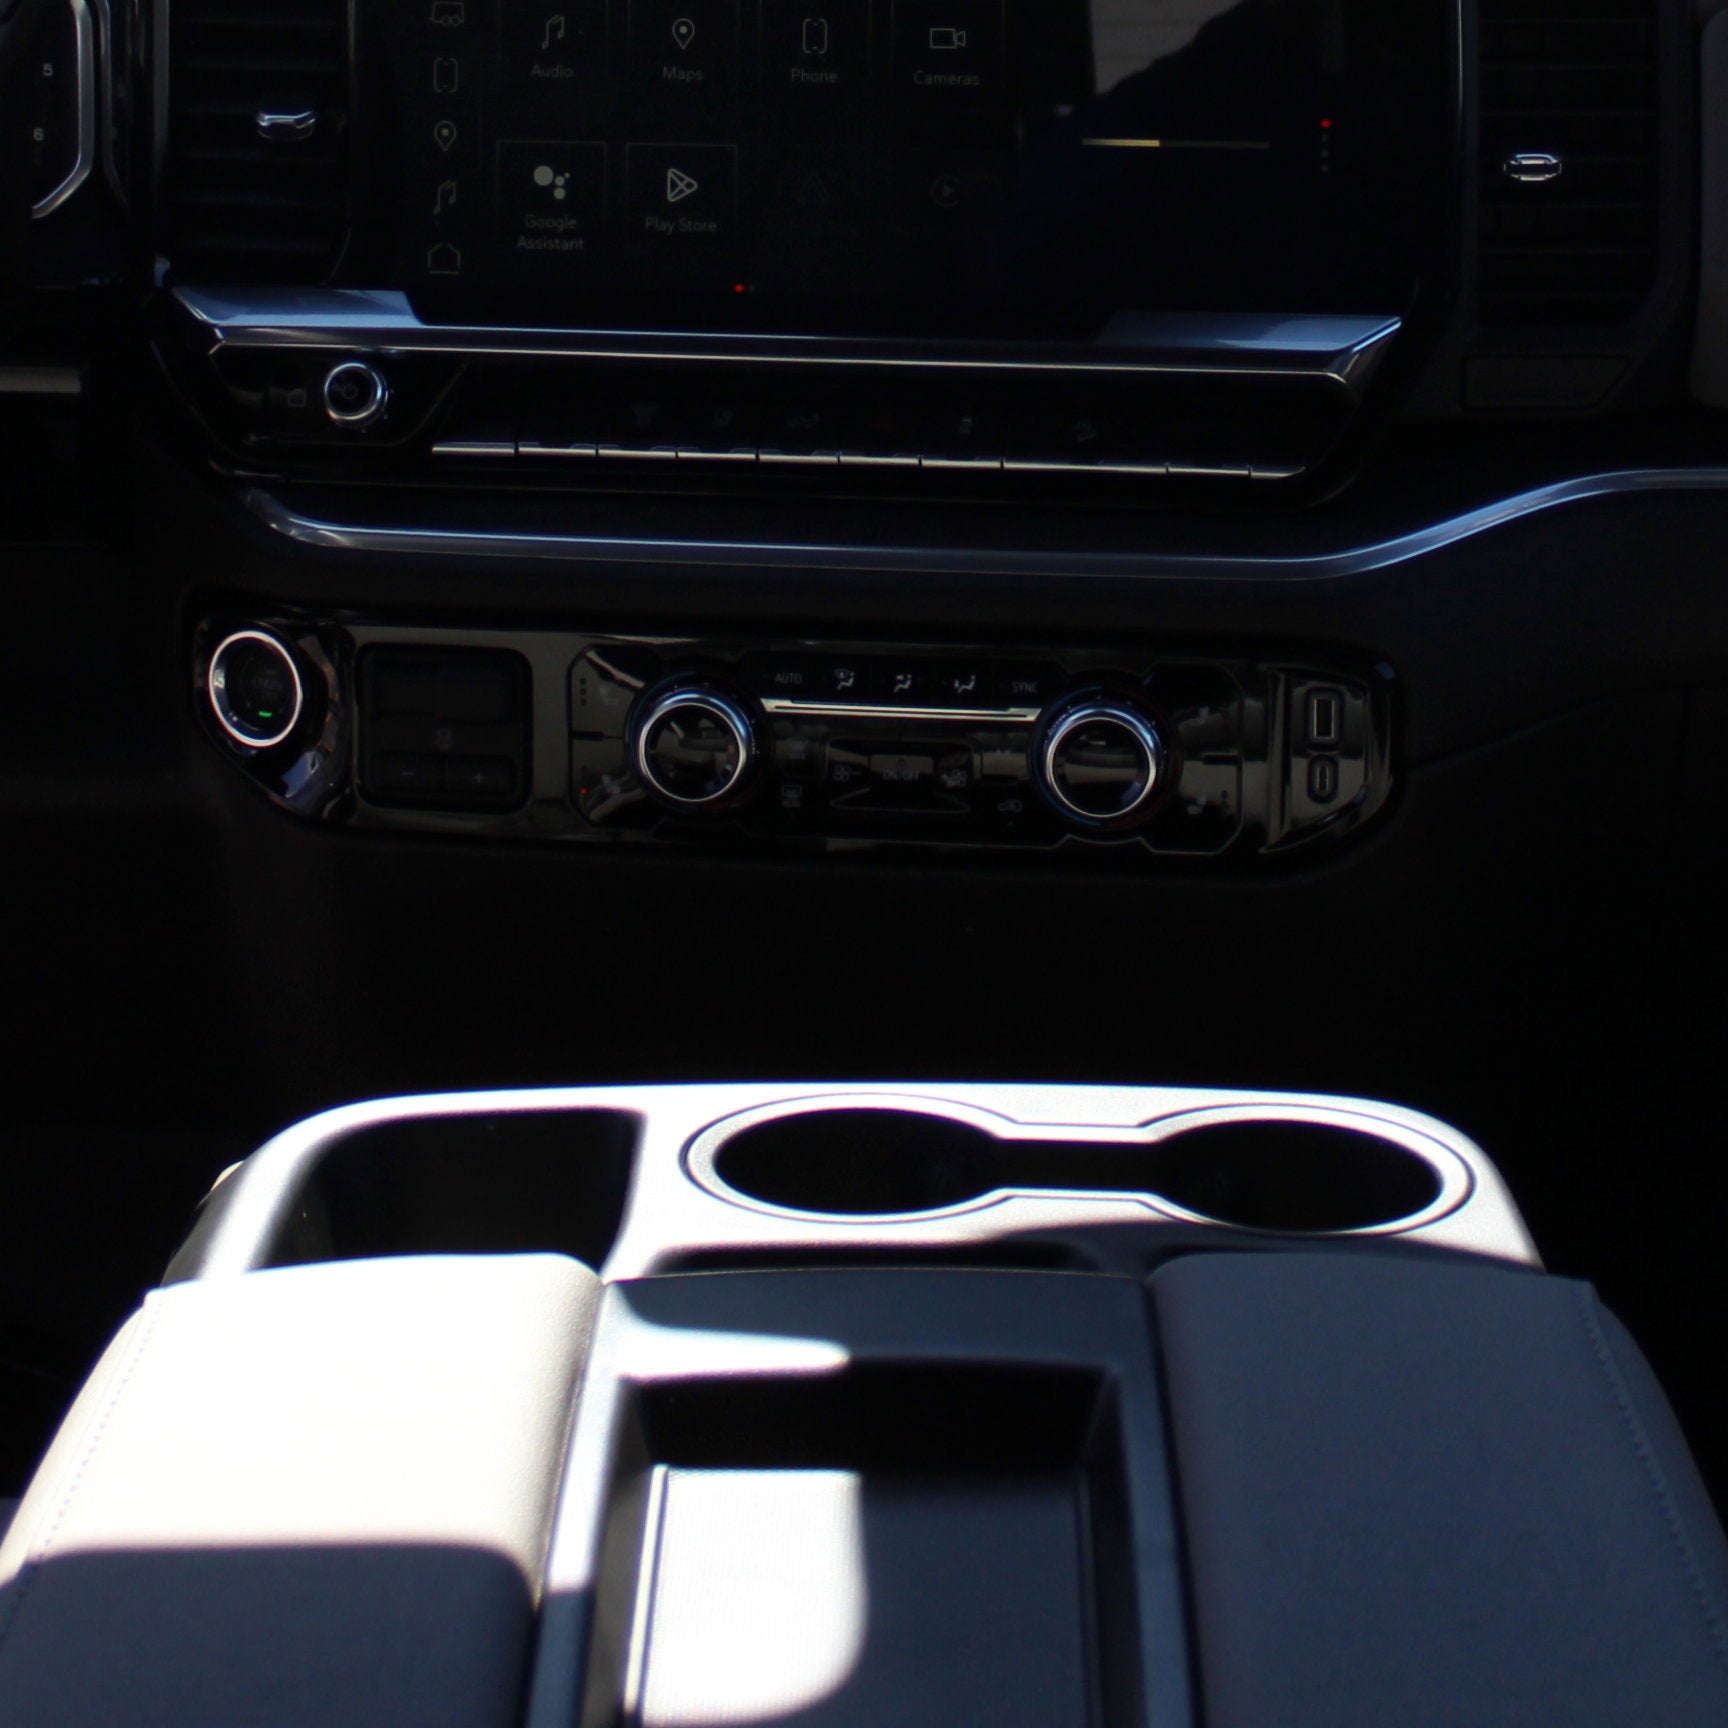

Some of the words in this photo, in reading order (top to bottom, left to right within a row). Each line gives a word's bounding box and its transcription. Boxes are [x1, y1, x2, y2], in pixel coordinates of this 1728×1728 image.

[531, 64, 574, 79] Audio
[662, 65, 704, 82] Maps
[791, 67, 838, 83] Phone
[912, 69, 981, 86] Cameras
[523, 214, 577, 231] Google
[645, 215, 673, 235] Play
[679, 216, 718, 233] Store
[516, 235, 584, 251] Assistant
[774, 671, 803, 685] AUTO
[1012, 680, 1038, 694] SYNC
